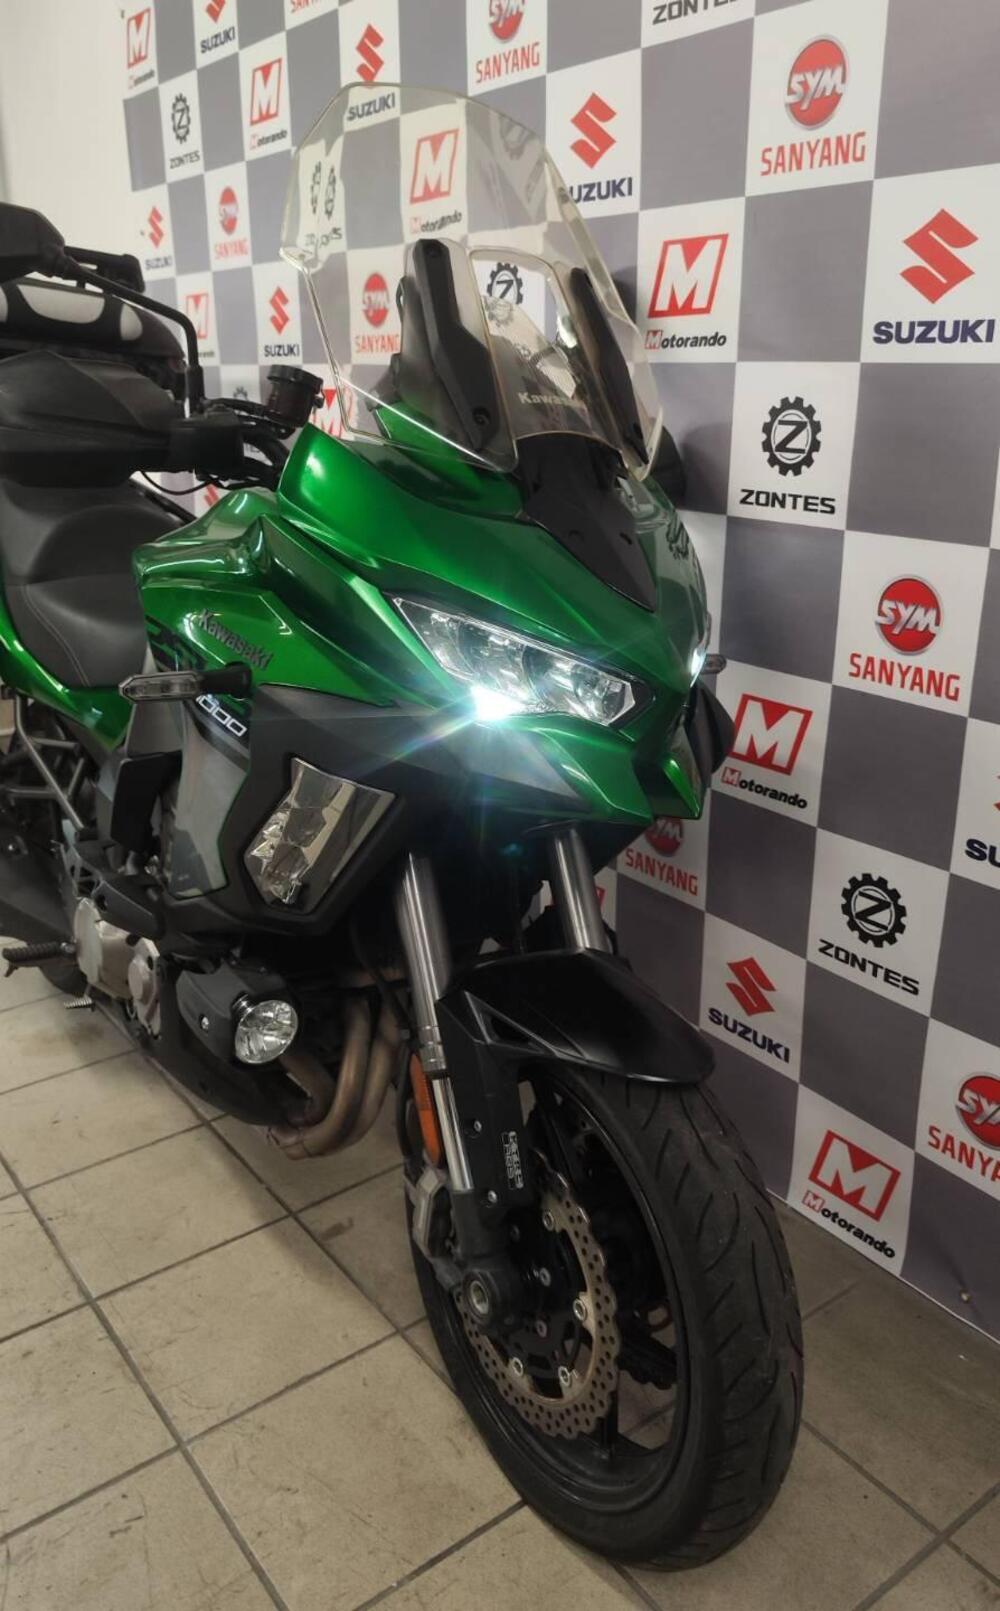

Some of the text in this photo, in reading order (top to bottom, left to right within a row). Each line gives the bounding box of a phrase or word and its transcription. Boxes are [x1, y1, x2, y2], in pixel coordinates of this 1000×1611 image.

[653, 0, 738, 25] ZONT
[200, 27, 236, 54] SUZUKI
[475, 41, 540, 83] SANYANG
[347, 92, 395, 121] SUZUKI
[784, 64, 846, 111] SYM
[761, 131, 866, 176] SANYANG
[561, 176, 633, 204] UZUKI
[264, 344, 300, 357] SUZUKI
[644, 330, 727, 350] Motorando
[872, 318, 996, 344] SUZUKI
[739, 488, 836, 515] ZONTES
[875, 599, 940, 634] SYM
[199, 608, 274, 671] Kawasaki
[849, 653, 960, 702] SANYANG
[721, 766, 808, 809] Motorando
[625, 848, 698, 896] SANYANG
[818, 938, 920, 996] ZONTES
[708, 1007, 790, 1063] SUZUKI
[803, 1191, 896, 1259] Motorando
